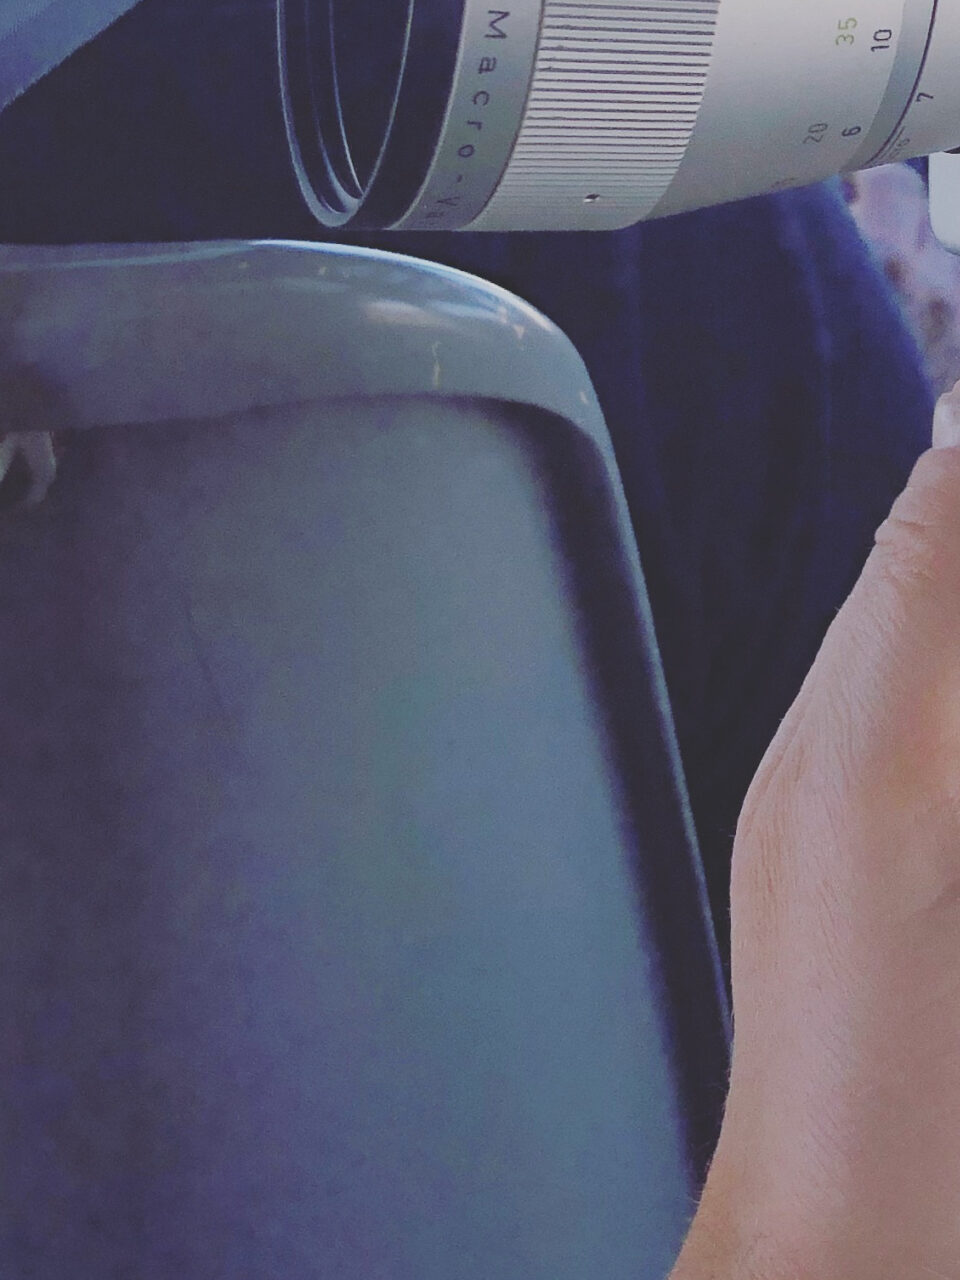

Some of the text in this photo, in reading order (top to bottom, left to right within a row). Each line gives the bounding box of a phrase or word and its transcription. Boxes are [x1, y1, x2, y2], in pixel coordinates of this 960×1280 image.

[835, 17, 857, 46] 35
[870, 28, 892, 52] 10
[916, 92, 935, 104] 7
